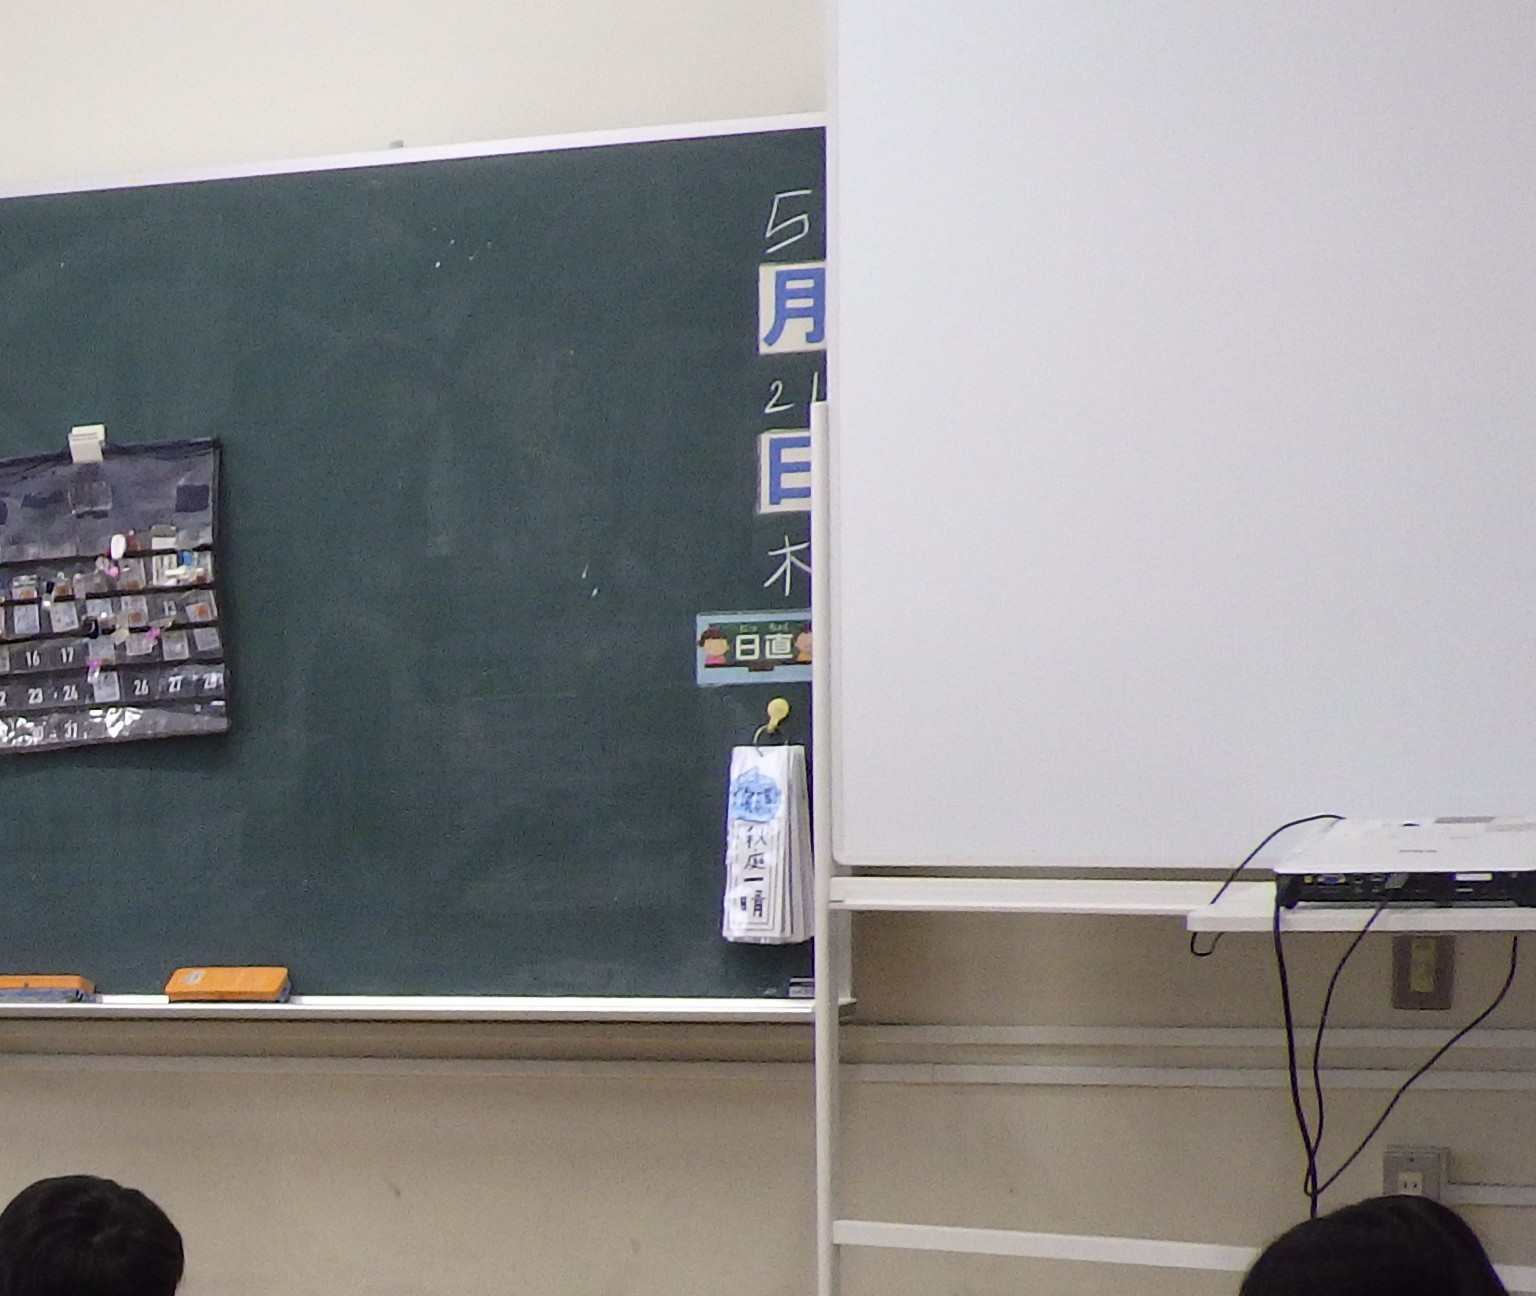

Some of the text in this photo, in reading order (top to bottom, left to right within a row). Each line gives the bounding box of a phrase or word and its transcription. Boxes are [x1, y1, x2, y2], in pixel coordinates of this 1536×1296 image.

[765, 189, 812, 254] 5
[763, 267, 826, 347] 月
[763, 535, 812, 597] 木
[26, 647, 74, 667] 16 17
[735, 633, 794, 660] 日直
[28, 687, 44, 704] 23
[133, 678, 149, 695] 26
[168, 674, 184, 693] 27
